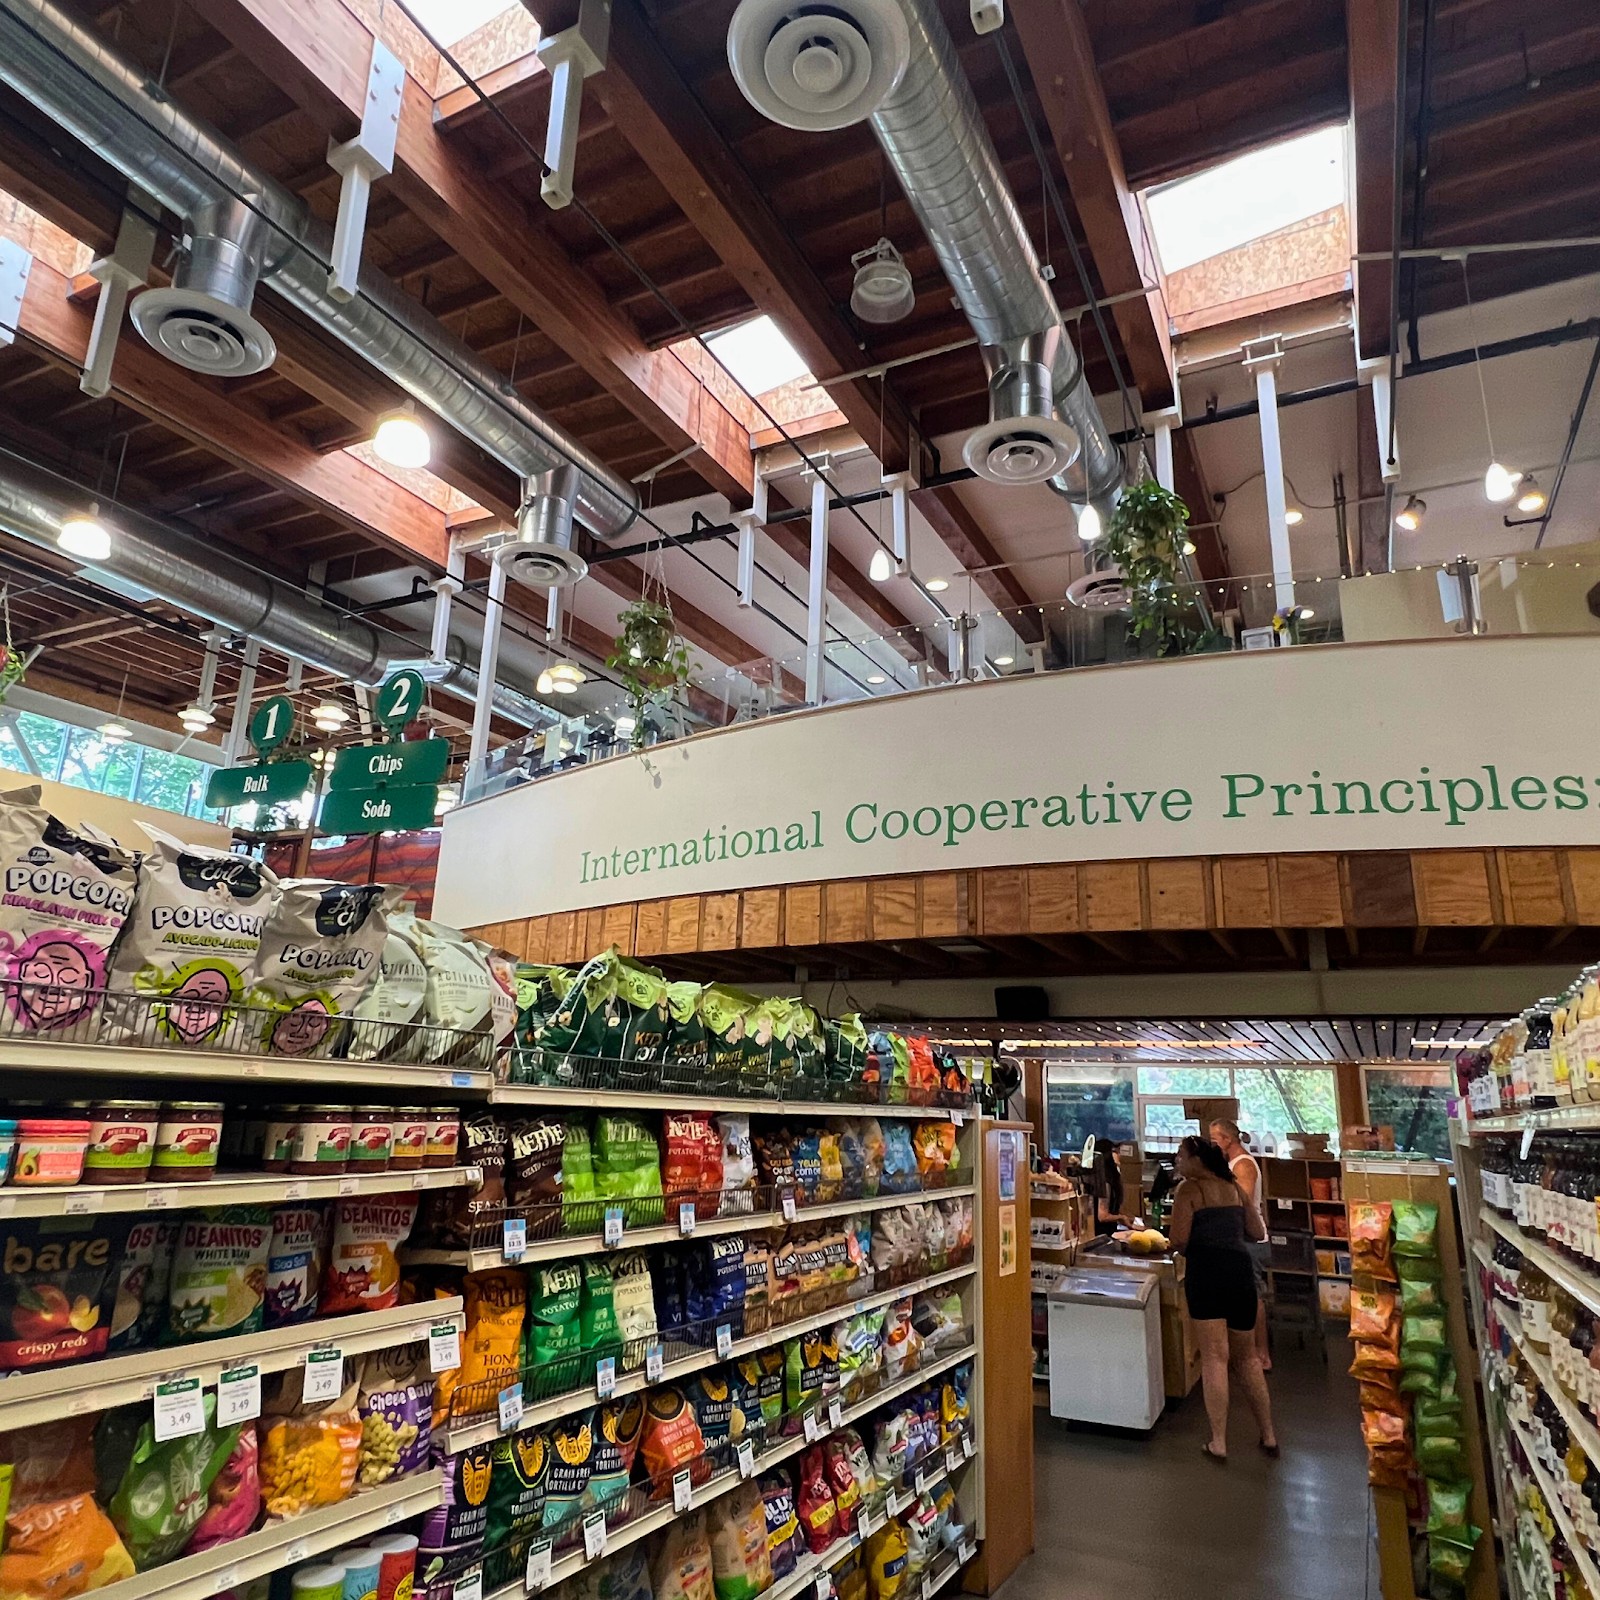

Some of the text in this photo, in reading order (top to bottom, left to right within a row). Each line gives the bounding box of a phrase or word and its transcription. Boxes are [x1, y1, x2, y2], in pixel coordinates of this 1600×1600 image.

[387, 677, 411, 717] 2
[262, 703, 280, 740] 1
[368, 753, 404, 775] Chips
[243, 774, 269, 794] Bulk
[361, 799, 392, 819] Soda
[579, 810, 825, 884] International
[845, 781, 1193, 846] Cooperative
[3, 1236, 110, 1274] bare
[195, 1249, 229, 1261] WHITE
[17, 1342, 58, 1357] crispy
[61, 1335, 88, 1348] reds
[439, 1352, 452, 1362] 3.49
[315, 1379, 332, 1392] 3.49
[231, 1399, 249, 1413] 3.49
[170, 1412, 191, 1427] 3.49
[553, 1469, 575, 1479] GRAIN
[459, 1510, 477, 1524] GRAIN
[450, 1522, 477, 1539] TORTILLA
